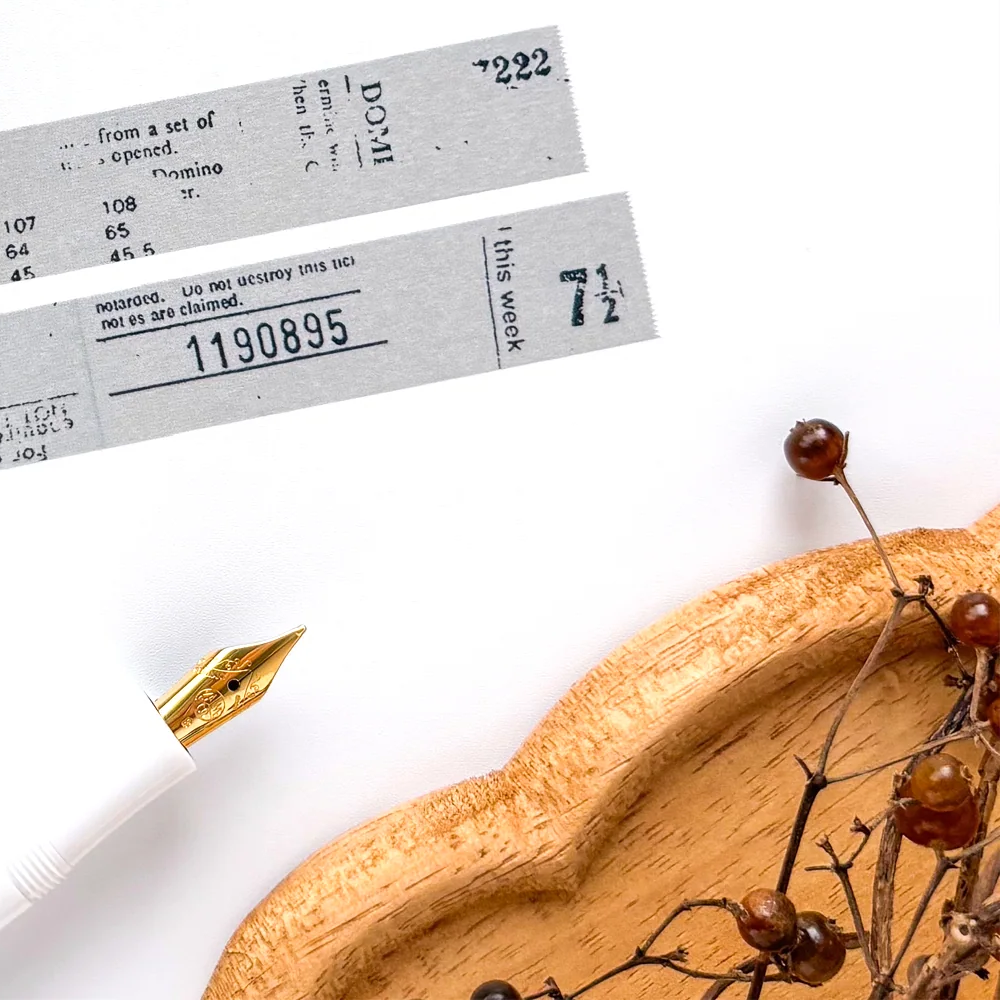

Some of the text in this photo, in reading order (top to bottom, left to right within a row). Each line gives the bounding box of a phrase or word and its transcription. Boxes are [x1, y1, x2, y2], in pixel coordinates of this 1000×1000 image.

[98, 110, 216, 145] from a set of
[111, 139, 179, 166] opened.
[102, 195, 138, 215] 108
[3, 215, 37, 235] 107
[104, 222, 131, 241] 65
[5, 242, 31, 260] 64
[493, 239, 516, 283] this
[11, 265, 37, 282] 45
[150, 307, 176, 323] are
[179, 293, 244, 317] claimed.
[500, 290, 526, 353] week
[186, 308, 349, 373] 1190895
